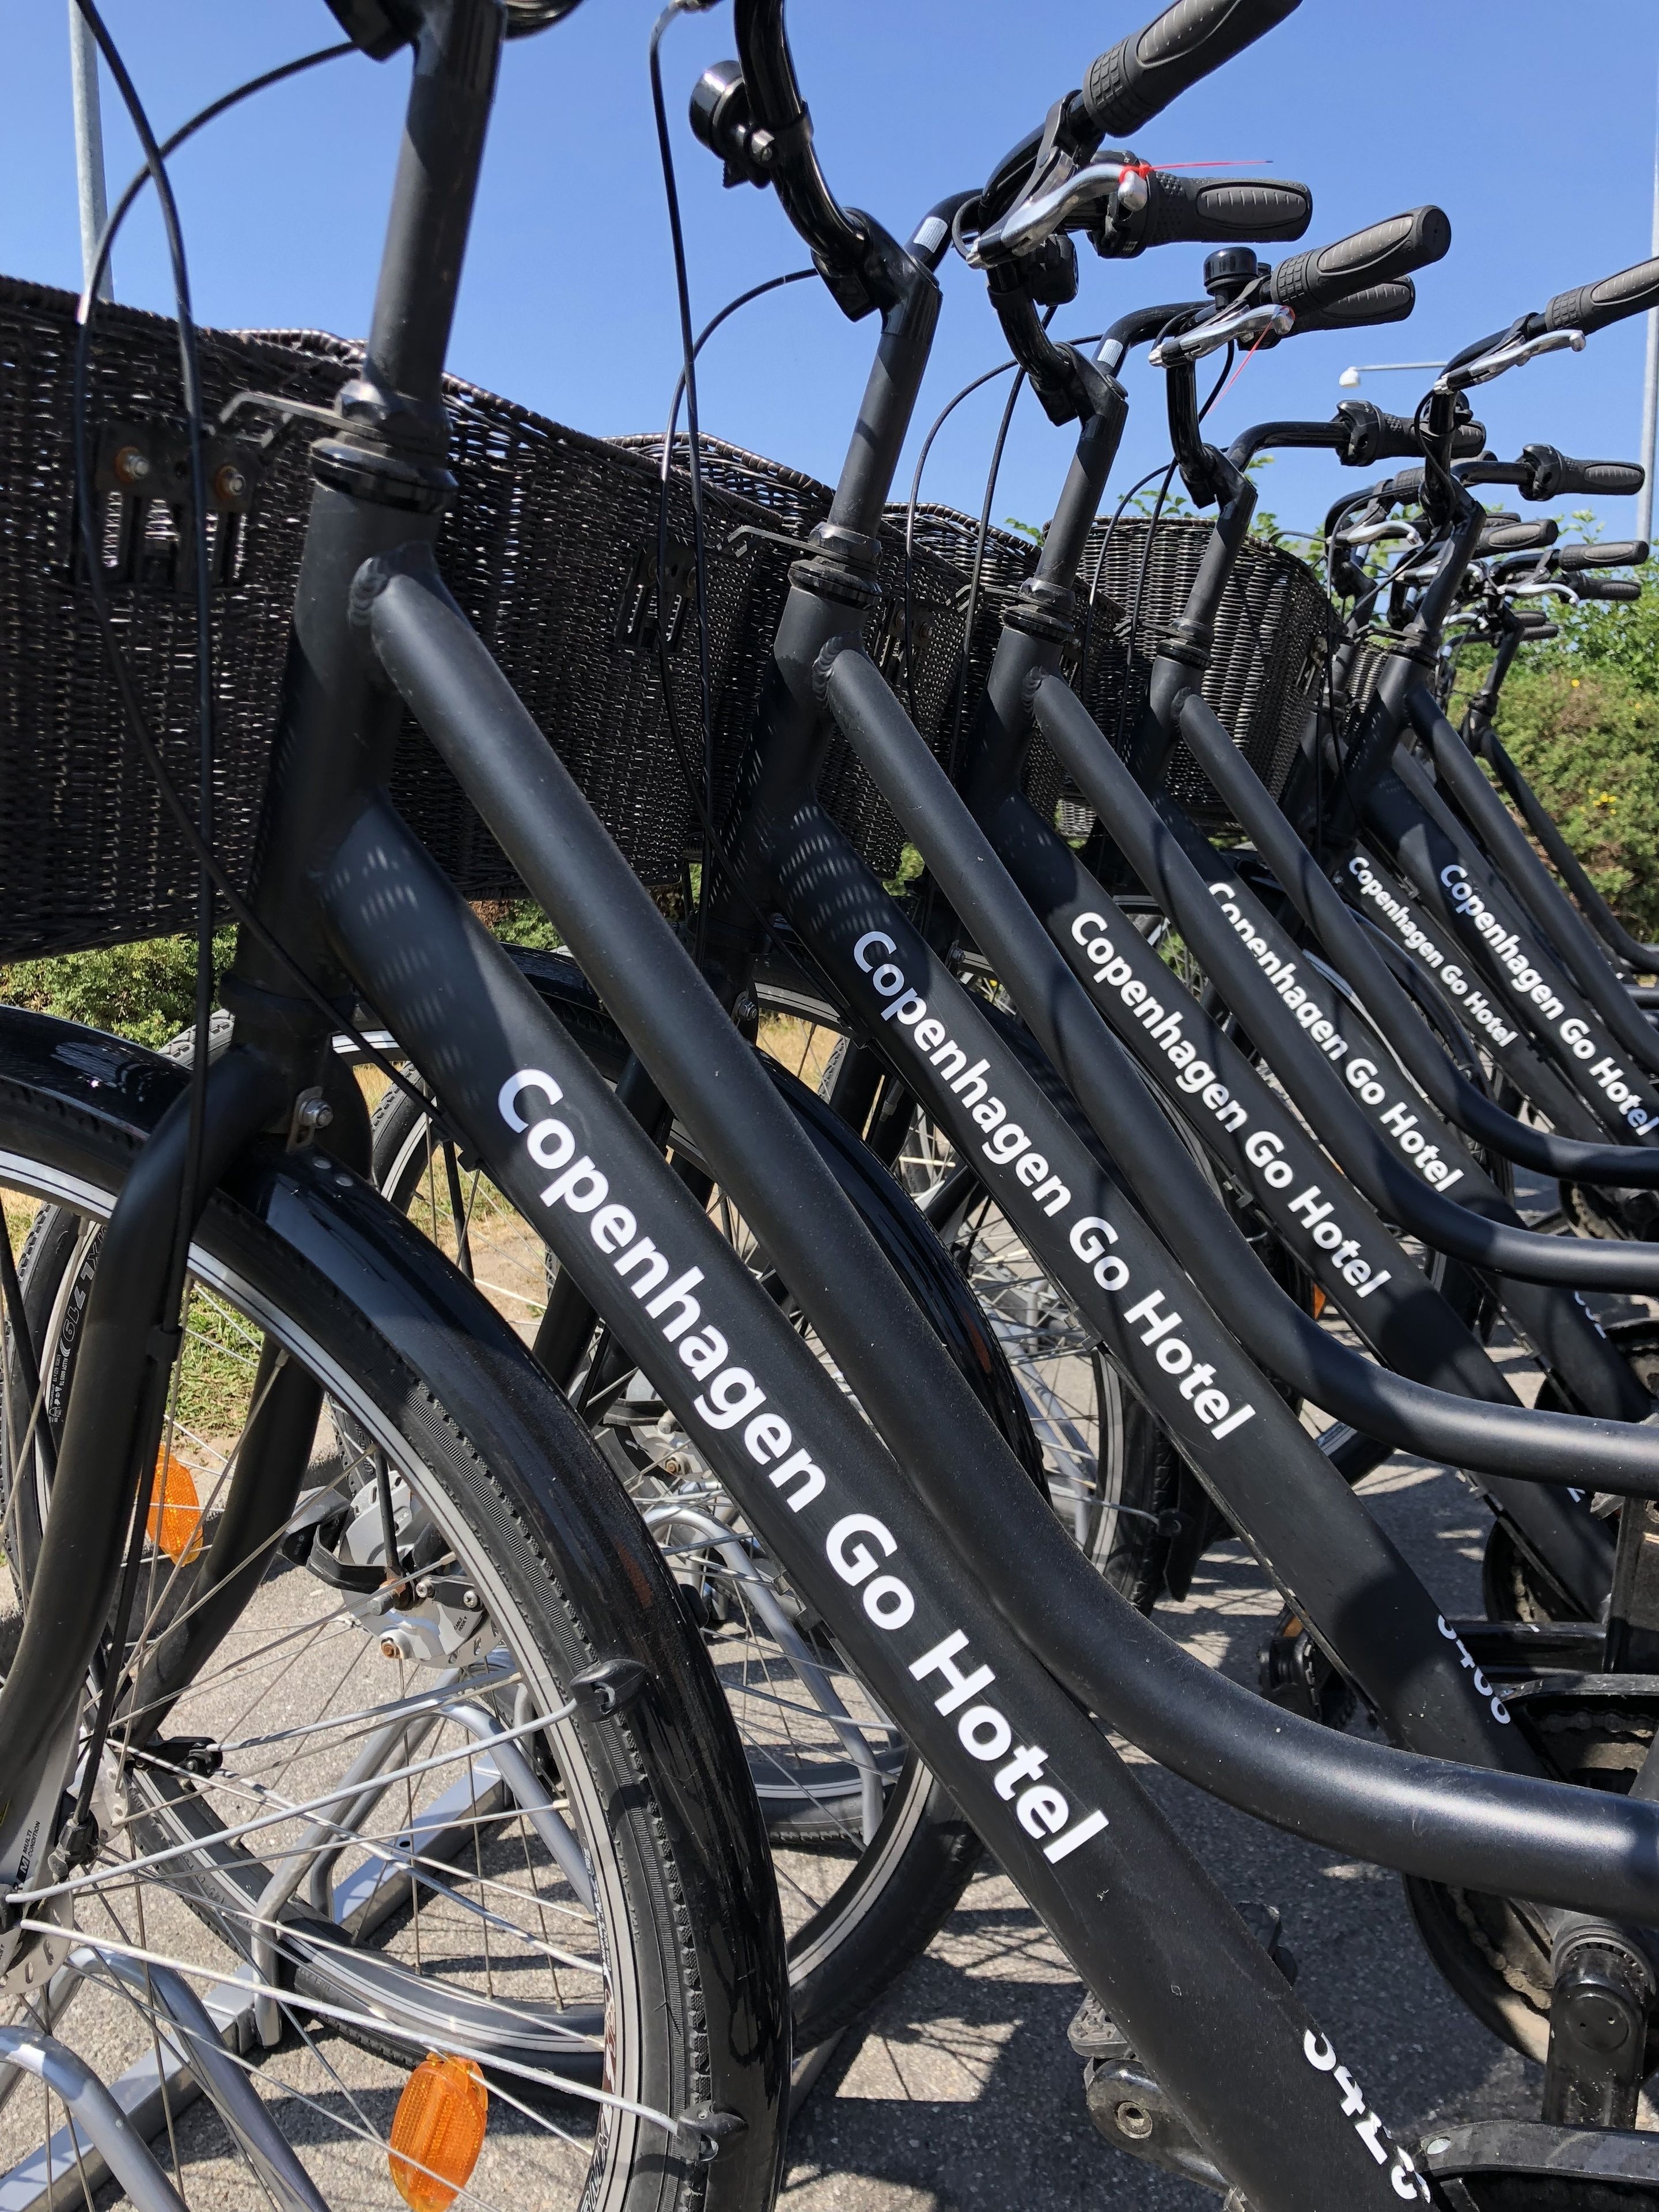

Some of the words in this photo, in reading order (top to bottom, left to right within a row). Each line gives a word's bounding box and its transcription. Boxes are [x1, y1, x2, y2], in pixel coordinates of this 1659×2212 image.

[1349, 856, 1445, 968] Copenhagen
[1440, 964, 1468, 995] Go
[1462, 990, 1518, 1048] Hotel
[1440, 864, 1565, 1020] Copenhagen
[1559, 1018, 1596, 1060] Go
[1589, 1056, 1659, 1137] Hotel
[854, 931, 1071, 1217] Copenhagen
[1069, 1216, 1130, 1291] Go
[1123, 1288, 1256, 1441] Hotel
[1070, 911, 1249, 1134] Copenhagen
[1244, 1131, 1294, 1189] Go
[1287, 1185, 1392, 1298] Hotel
[1346, 1058, 1385, 1105] Go
[1380, 1101, 1465, 1193] Hotel
[63, 1285, 86, 1342] 719
[498, 1069, 826, 1514] Copenhagen
[825, 1513, 915, 1631] Go
[908, 1628, 1110, 1865] Hotel
[454, 1617, 463, 1630] CABLE
[22, 1829, 33, 1854] MULTI
